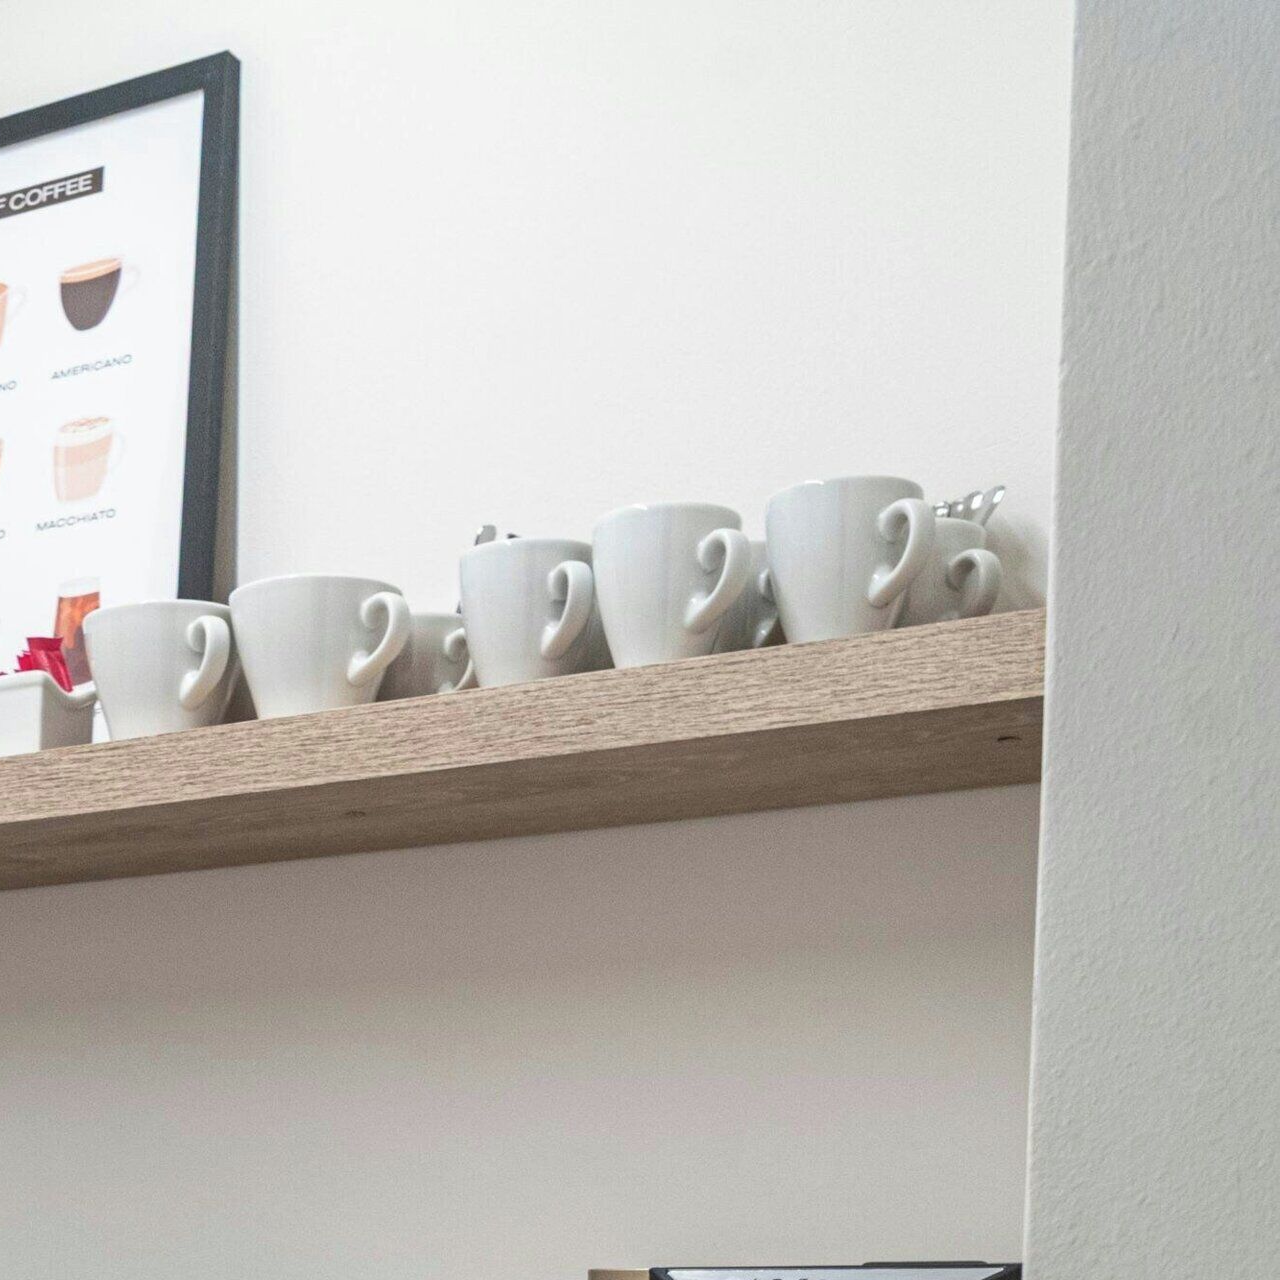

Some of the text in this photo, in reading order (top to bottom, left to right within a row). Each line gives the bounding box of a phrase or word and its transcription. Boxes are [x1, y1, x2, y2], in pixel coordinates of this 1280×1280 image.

[8, 173, 94, 211] COFFEE
[51, 353, 133, 380] AMERICANO
[35, 508, 117, 532] MACCHIATO
